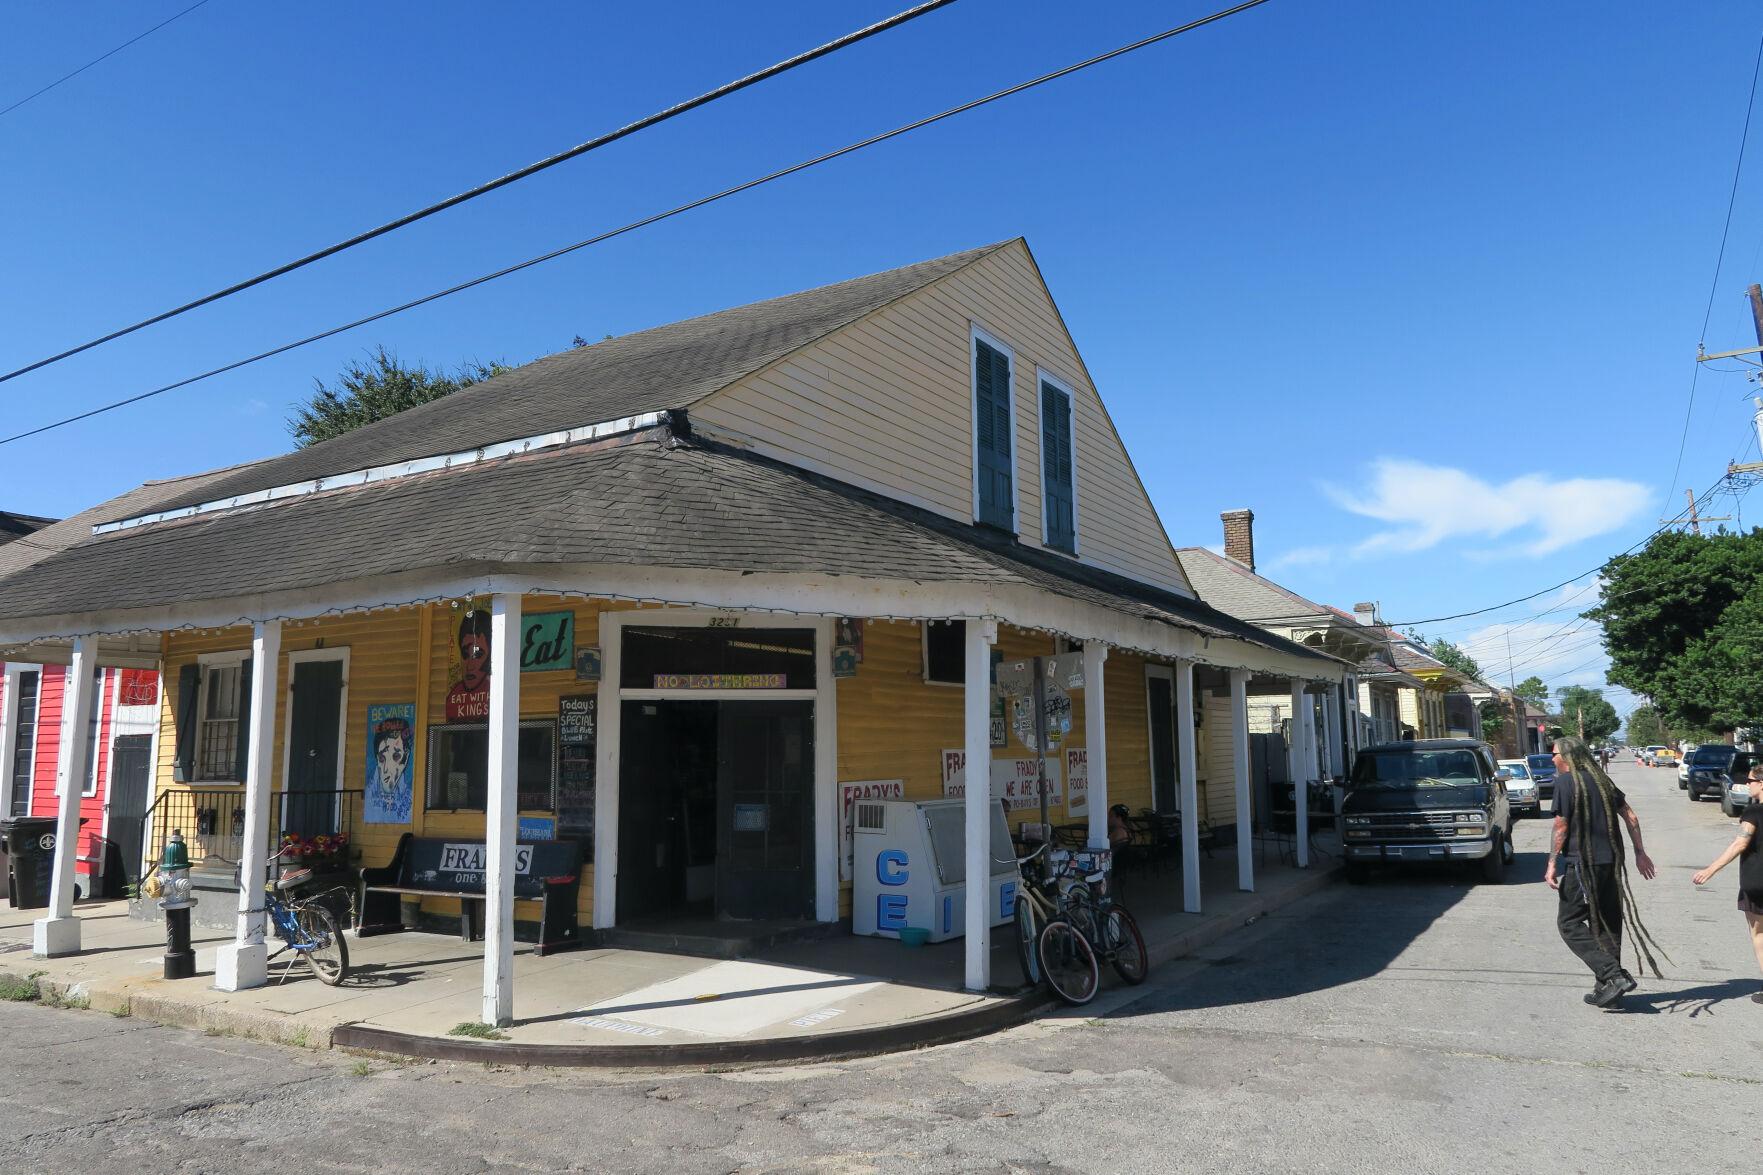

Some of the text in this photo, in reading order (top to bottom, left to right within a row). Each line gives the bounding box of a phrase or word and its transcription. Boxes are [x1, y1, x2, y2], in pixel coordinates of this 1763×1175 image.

[520, 618, 569, 667] Eat
[656, 675, 678, 688] NO
[452, 694, 467, 704] EAT
[561, 699, 595, 713] Todays
[371, 705, 414, 721] BEWARE!
[560, 715, 595, 726] SPECIAL
[1006, 781, 1015, 797] WE
[1021, 780, 1032, 795] ARE
